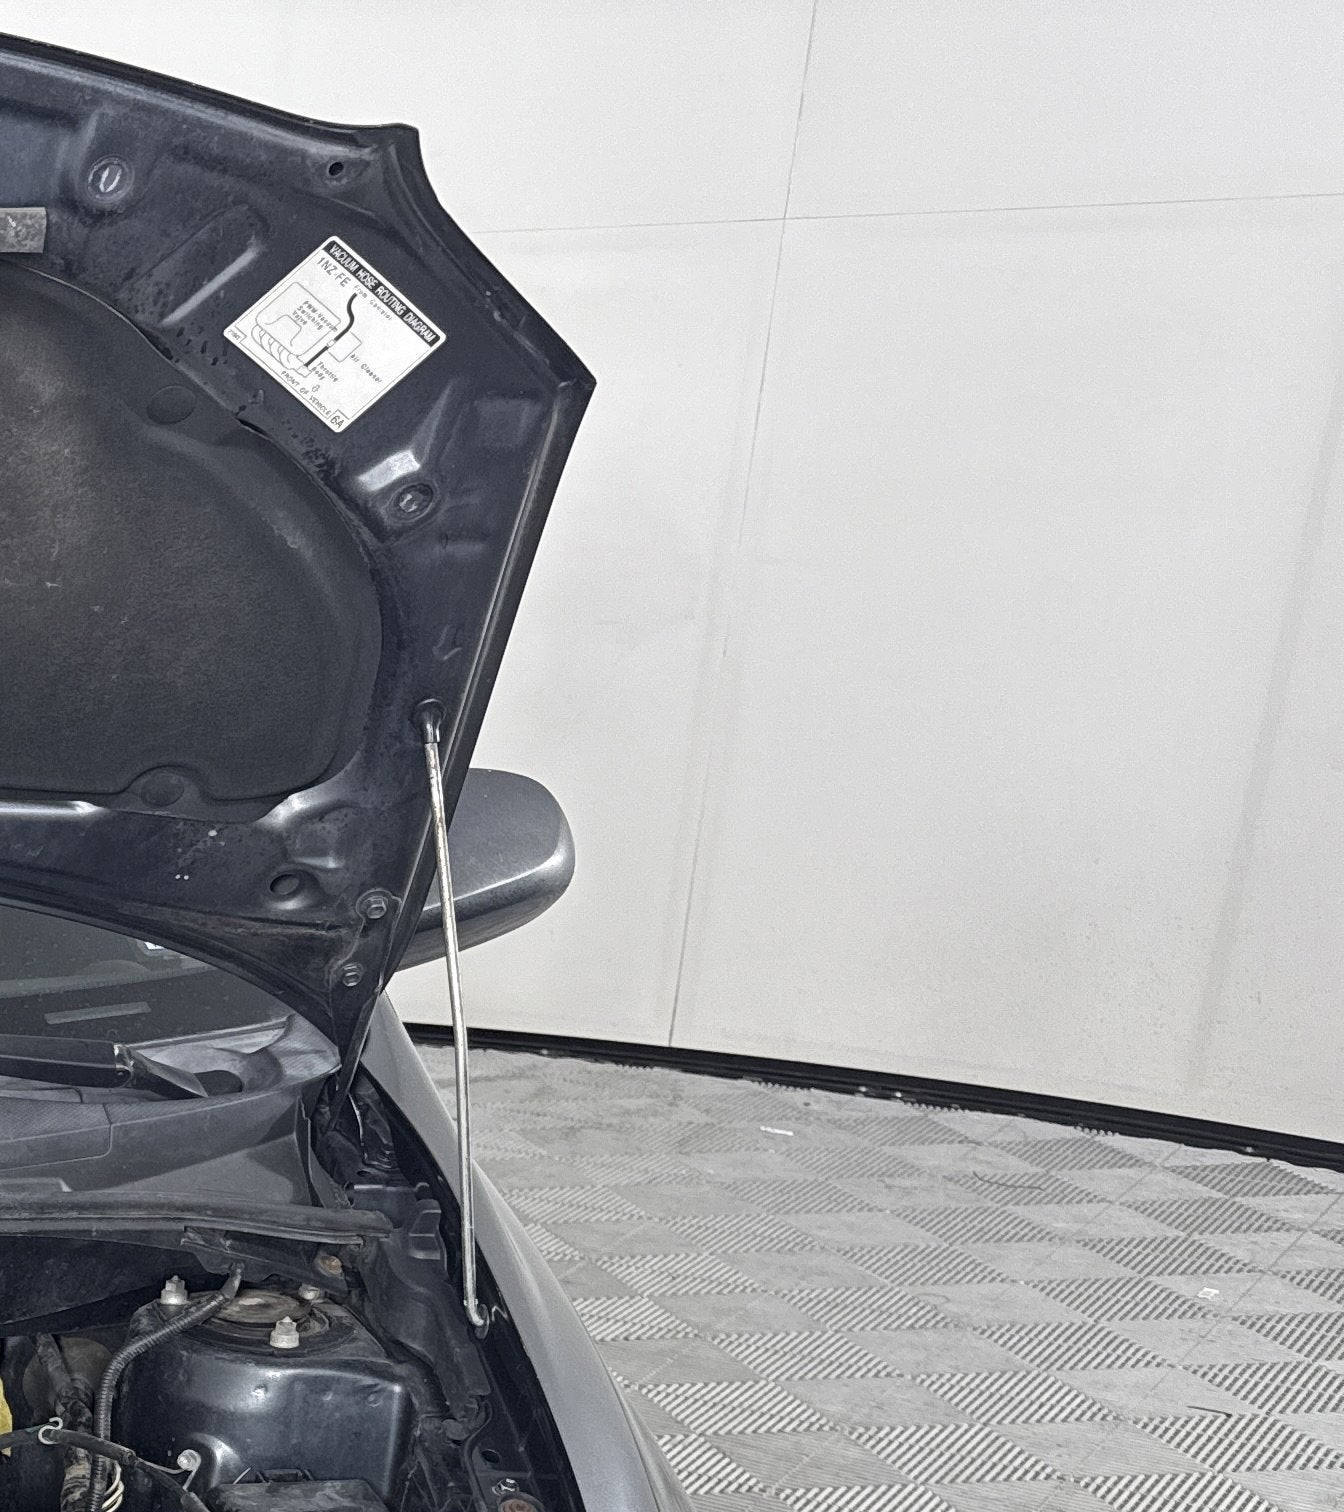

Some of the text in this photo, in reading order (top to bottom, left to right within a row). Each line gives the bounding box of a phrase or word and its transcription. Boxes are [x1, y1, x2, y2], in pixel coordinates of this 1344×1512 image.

[328, 243, 437, 343] VACUUM HOSE ROUTING DIAGRAM
[351, 283, 369, 300] From
[279, 369, 332, 416] FRONT OF VEHICLE
[329, 413, 345, 429] 6A
